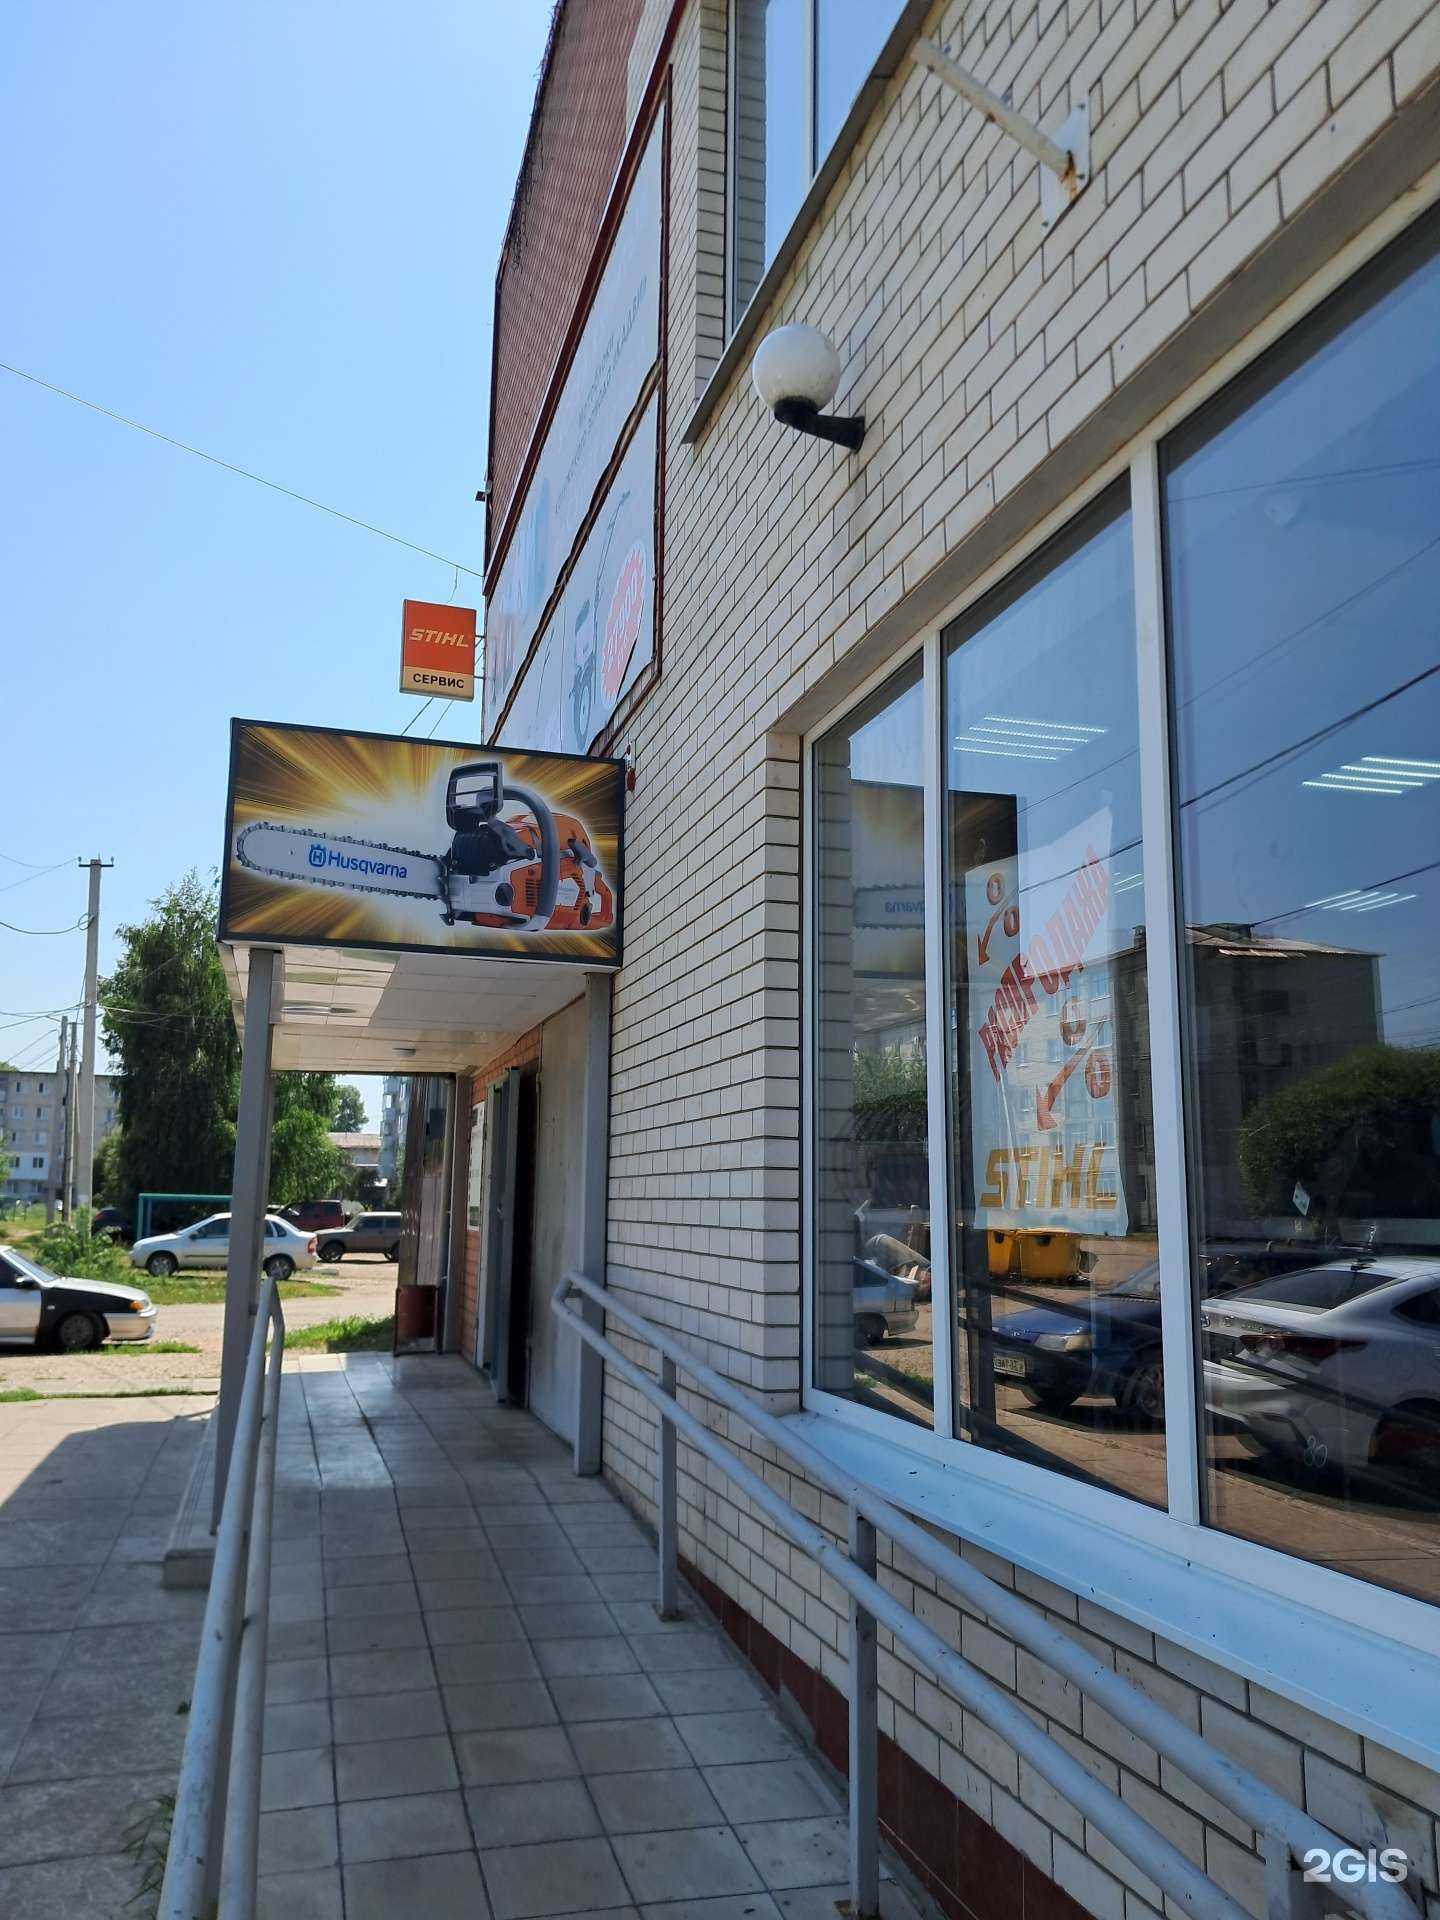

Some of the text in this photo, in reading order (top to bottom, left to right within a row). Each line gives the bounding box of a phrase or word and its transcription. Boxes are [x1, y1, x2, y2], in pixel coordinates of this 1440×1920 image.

[409, 628, 469, 648] STIHL
[413, 673, 464, 689] СЕРВИС
[328, 850, 407, 878] Husqvarna
[978, 844, 1109, 1082] РАСПРОДАЖА
[980, 1143, 1118, 1209] STIHL
